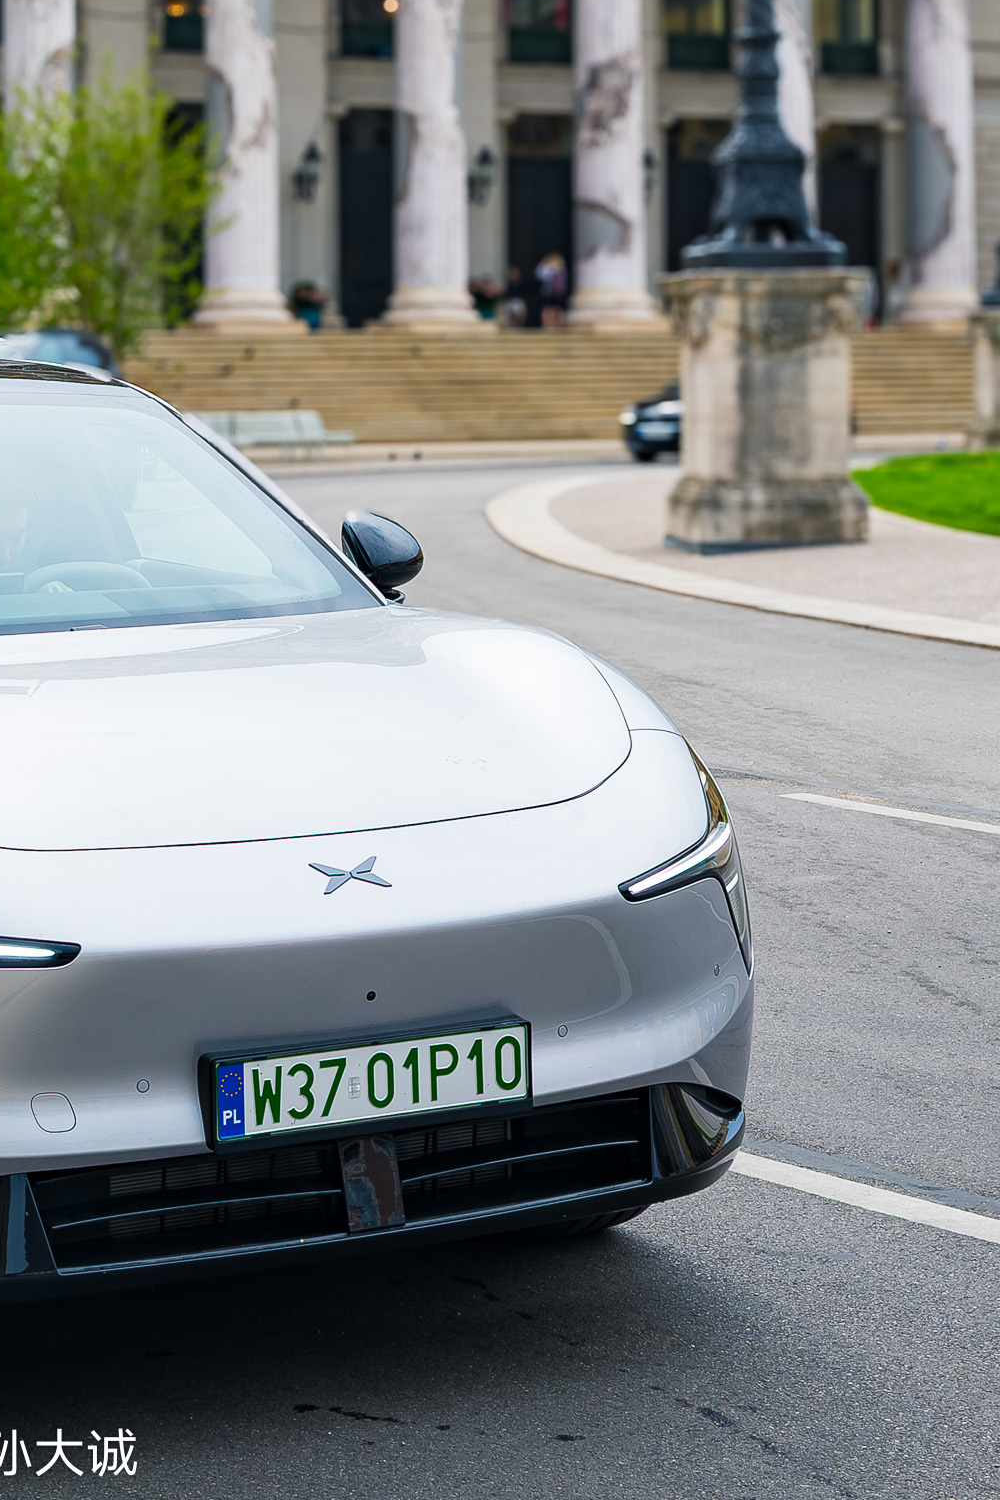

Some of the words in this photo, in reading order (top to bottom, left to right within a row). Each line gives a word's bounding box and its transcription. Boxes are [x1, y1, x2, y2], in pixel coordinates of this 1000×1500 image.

[251, 1056, 347, 1127] W37
[366, 1034, 522, 1110] 01P10
[222, 1108, 242, 1126] PL
